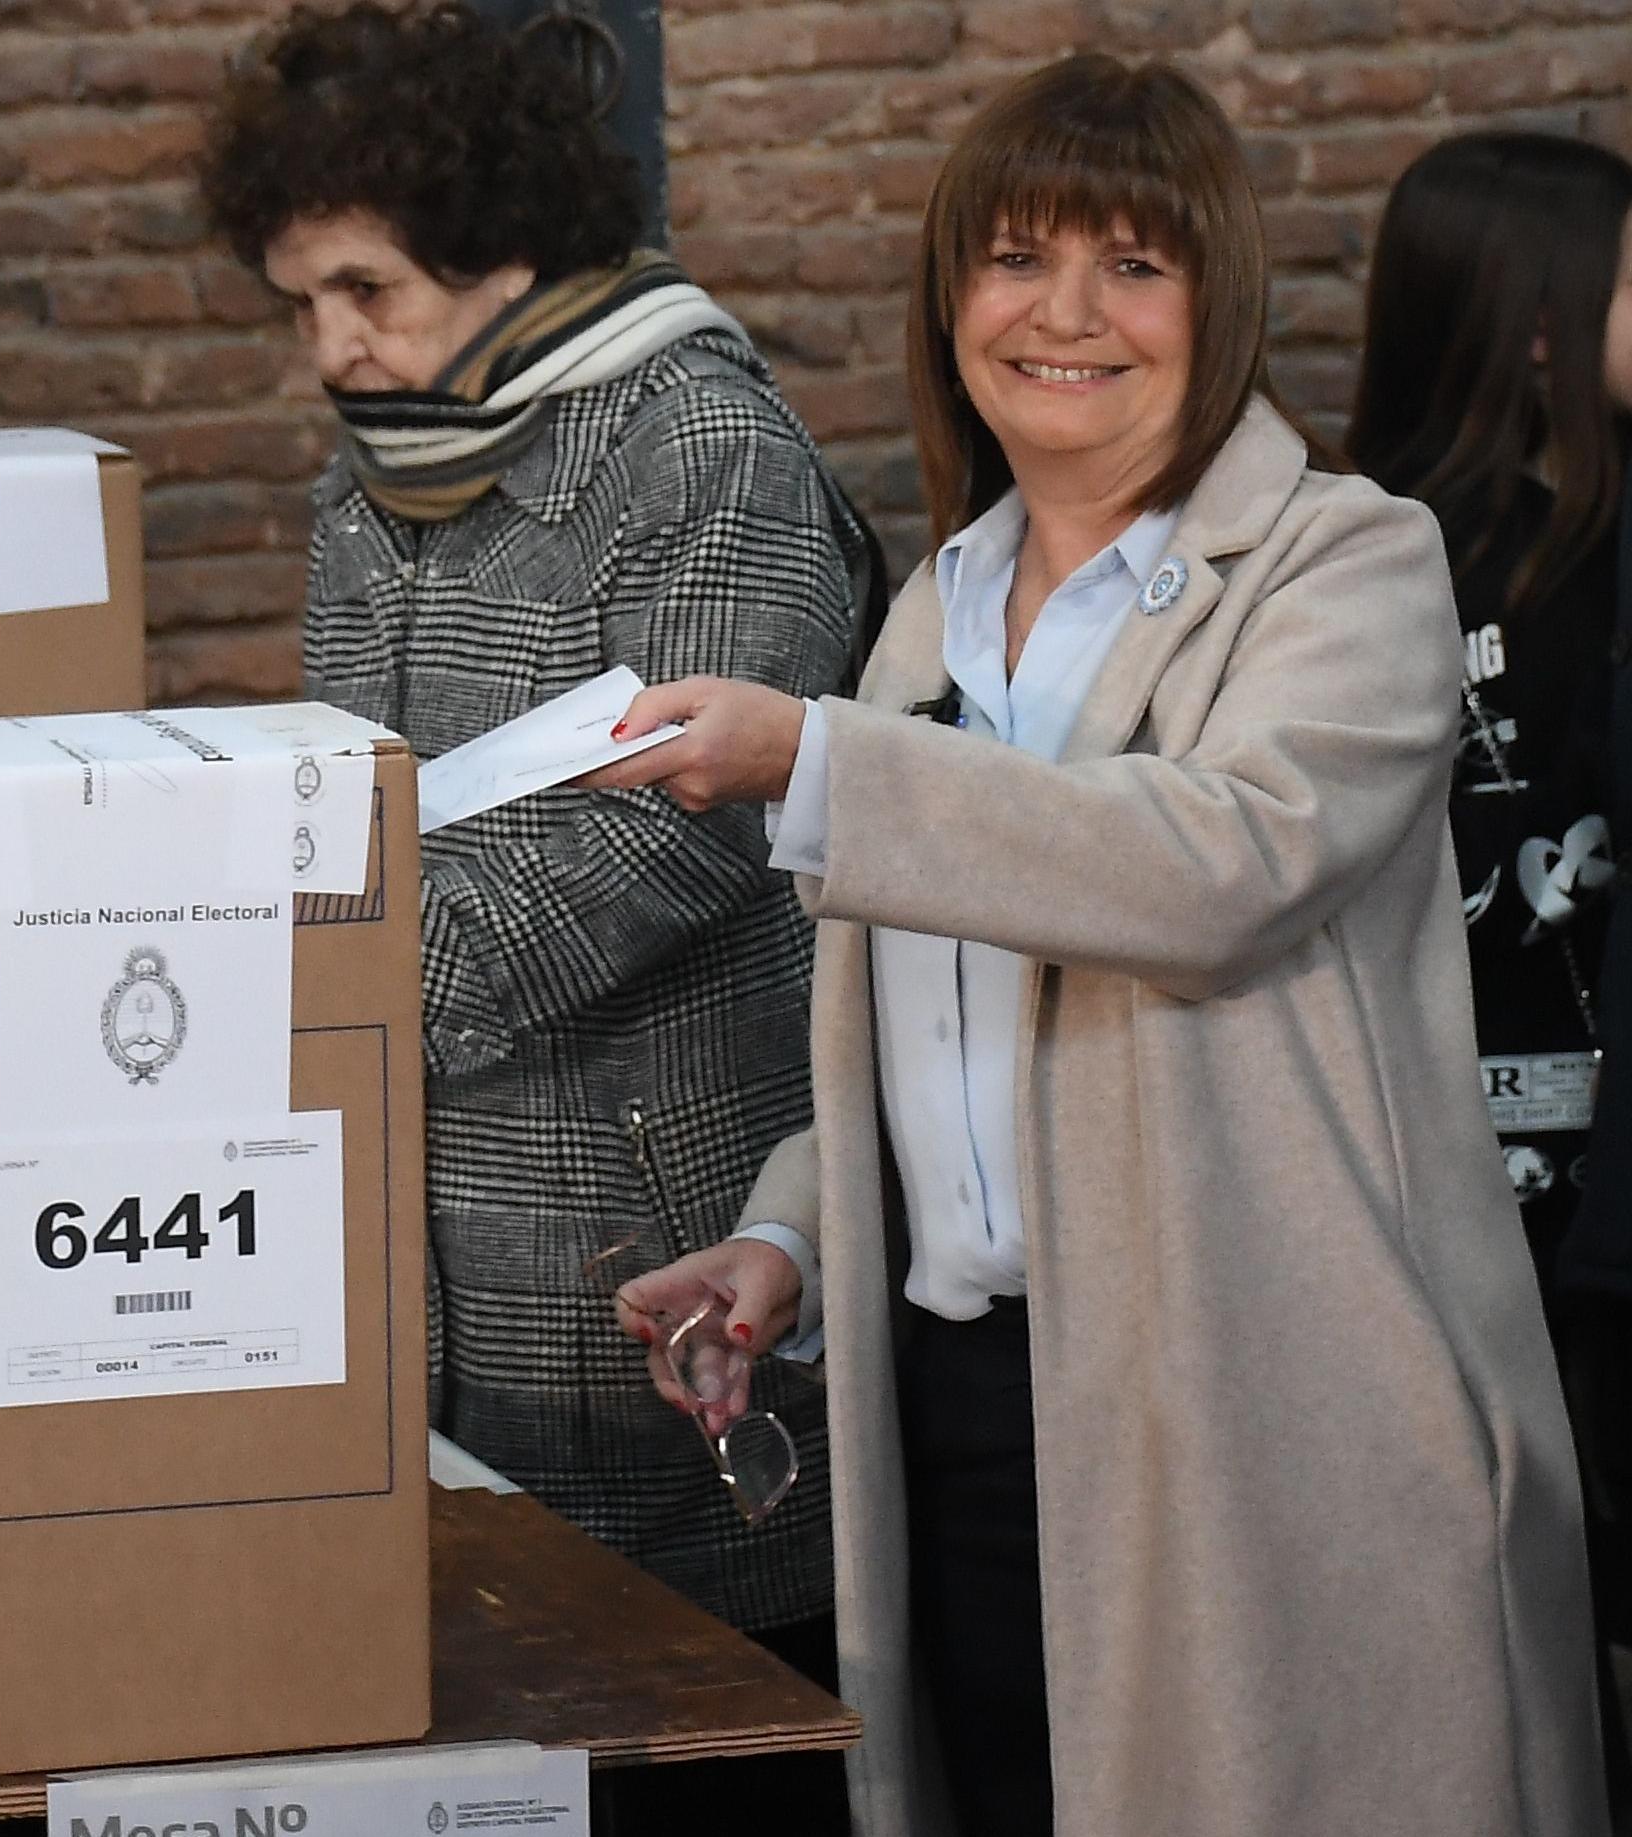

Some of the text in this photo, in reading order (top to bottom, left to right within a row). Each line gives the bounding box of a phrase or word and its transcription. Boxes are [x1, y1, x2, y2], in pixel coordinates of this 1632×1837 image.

[13, 903, 279, 926] Justicia Nacional Electoral
[1489, 1067, 1522, 1096] R
[35, 1190, 256, 1269] 6441
[96, 1360, 139, 1373] 00014
[244, 1351, 278, 1363] 0151
